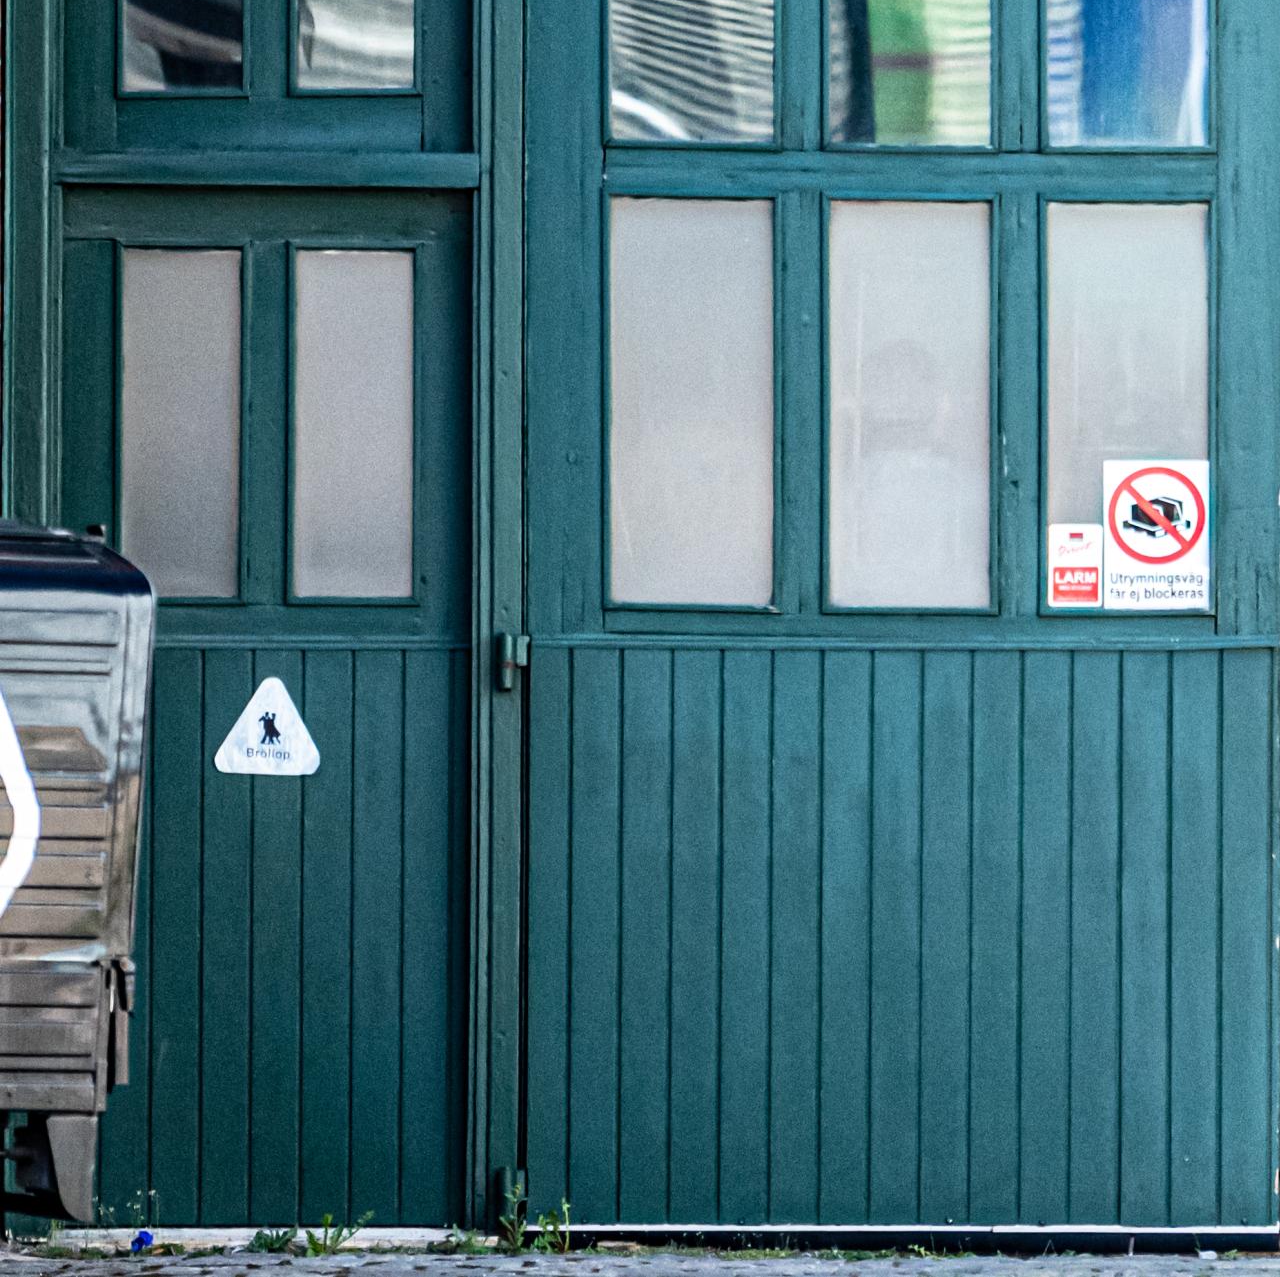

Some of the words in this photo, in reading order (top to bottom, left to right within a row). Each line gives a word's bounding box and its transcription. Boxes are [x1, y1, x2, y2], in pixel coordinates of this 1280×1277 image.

[1054, 571, 1097, 584] LARM
[1110, 572, 1204, 587] Utrymningsväg
[1130, 588, 1140, 602] ej
[1144, 587, 1204, 600] blockeras
